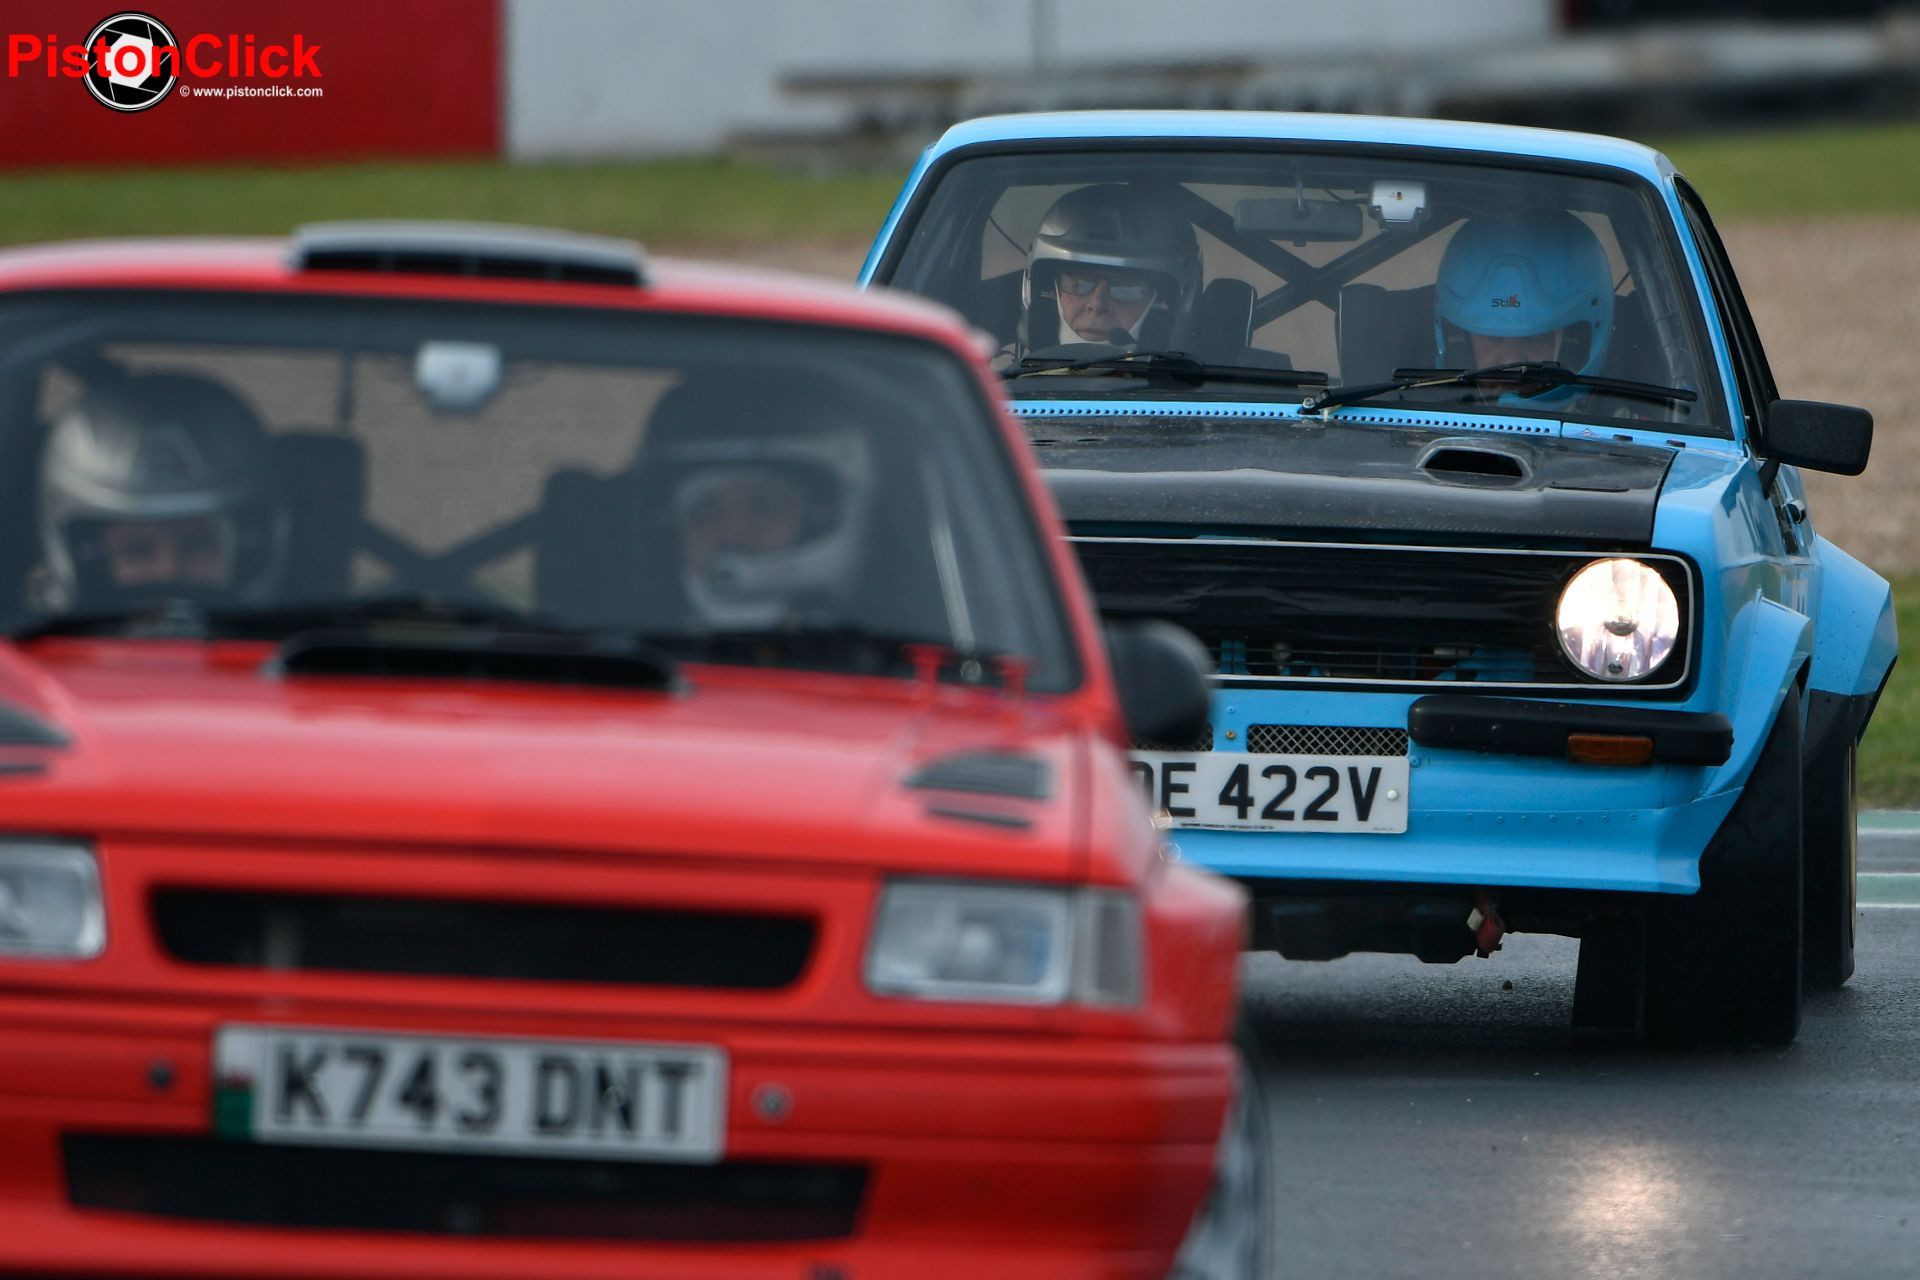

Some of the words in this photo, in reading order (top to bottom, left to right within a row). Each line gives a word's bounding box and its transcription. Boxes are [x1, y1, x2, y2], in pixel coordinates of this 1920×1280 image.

[1218, 763, 1382, 822] 422V
[275, 1040, 505, 1132] K743
[530, 1053, 700, 1137] DNT
